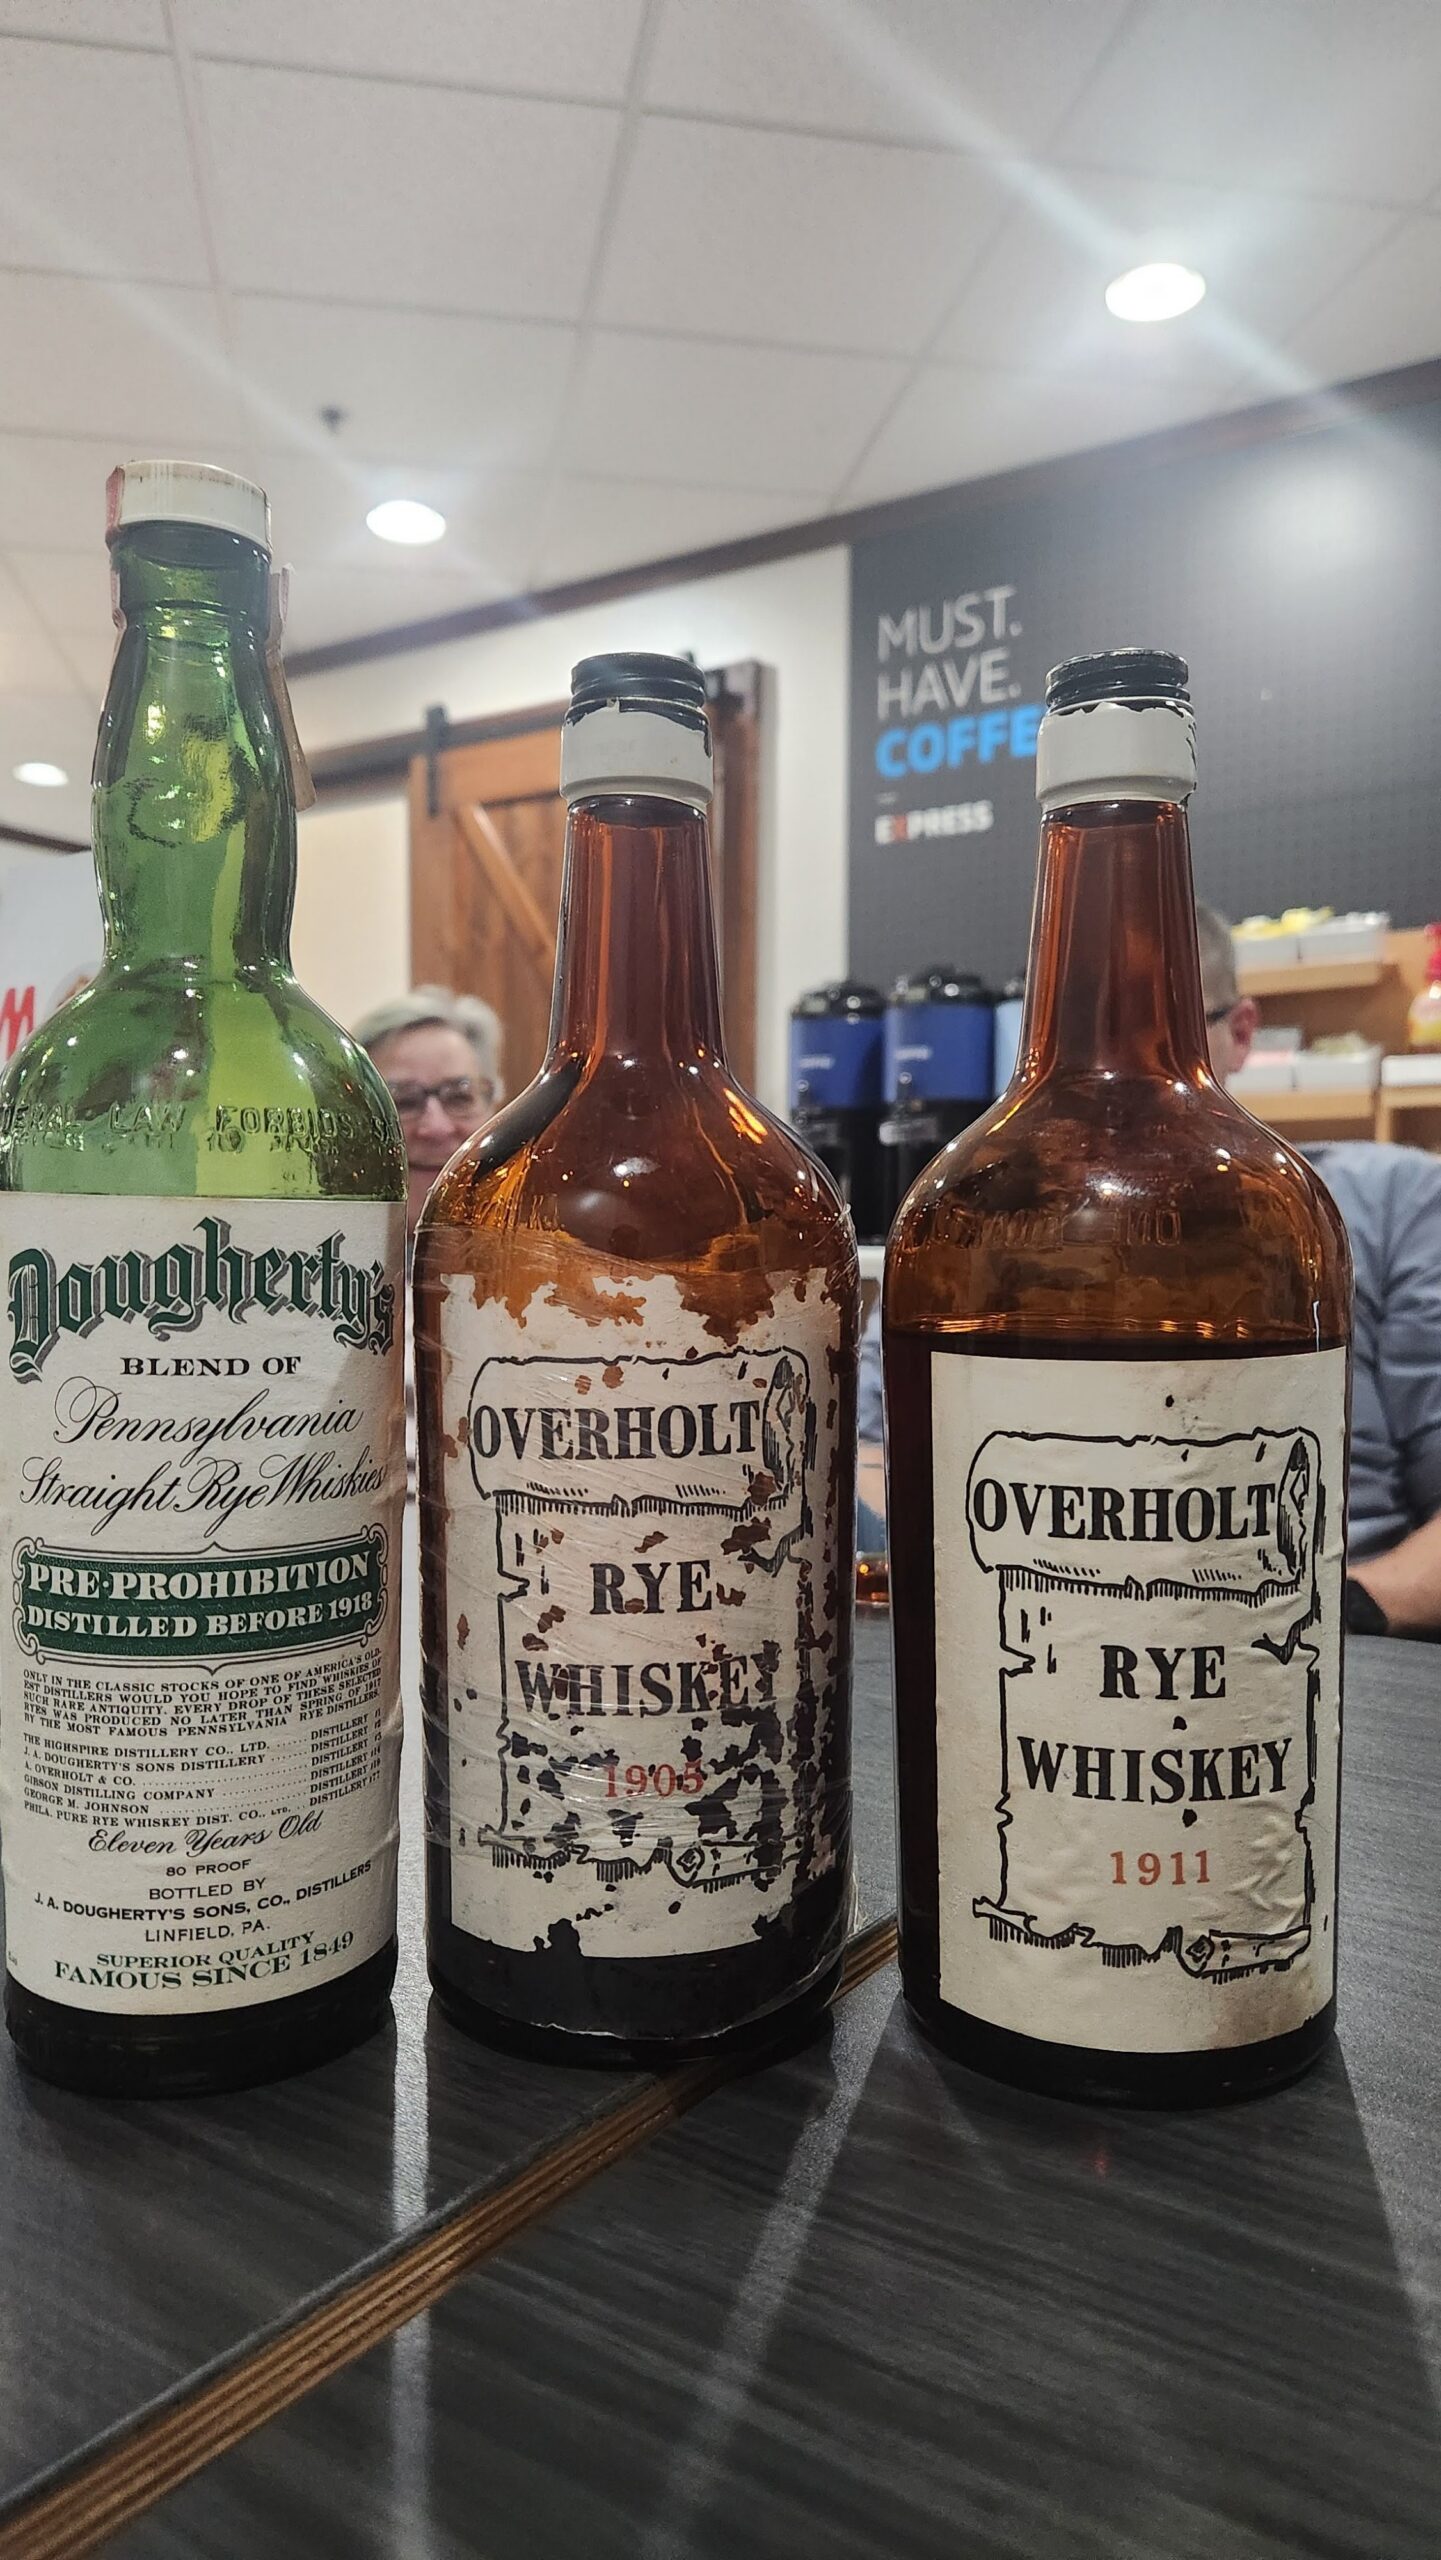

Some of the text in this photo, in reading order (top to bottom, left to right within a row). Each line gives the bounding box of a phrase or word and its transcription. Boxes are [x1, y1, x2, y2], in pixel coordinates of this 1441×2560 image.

[877, 584, 1023, 663] MUST.
[877, 646, 1022, 721] HAVE.
[874, 702, 1045, 778] COFFE
[8, 1216, 395, 1384] Dougherty's
[120, 1356, 301, 1377] BLEND OF
[53, 1376, 364, 1468] Pennsylvania
[472, 1400, 760, 1460] OVERHOLT
[20, 1445, 388, 1538] Straight Rye Whiskies
[973, 1478, 1276, 1543] OVERHOLT
[590, 1559, 712, 1615] RYE
[27, 1591, 372, 1638] DISTILLED BEFORE 1918
[23, 1669, 48, 1683] ONLY
[51, 1675, 63, 1686] IN
[67, 1678, 91, 1690] THE
[96, 1681, 155, 1692] CLASSIC
[160, 1681, 220, 1692] STOCKS
[225, 1679, 245, 1689] OF
[250, 1674, 280, 1686] ONE
[284, 1670, 302, 1682] OF
[305, 1655, 362, 1678] AMERICA'S
[24, 1680, 40, 1692] EST
[44, 1685, 112, 1703] DISTILLERS
[119, 1694, 173, 1704] WOULD
[180, 1692, 210, 1703] YOU
[218, 1688, 258, 1701] HOPE
[264, 1685, 282, 1696] TO
[288, 1679, 317, 1692] FIND
[322, 1662, 370, 1684] WHISKIES
[24, 1691, 49, 1706] SUCH
[53, 1698, 85, 1712] RARE
[174, 1703, 222, 1715] EVERY
[228, 1698, 268, 1711] DROP
[273, 1694, 292, 1705] OF
[296, 1684, 335, 1702] THESE
[339, 1667, 381, 1691] SELECTED
[514, 1654, 778, 1718] WHISKEY
[1099, 1644, 1226, 1700] RYE
[24, 1702, 47, 1716] RYES
[53, 1709, 77, 1721] WAS
[85, 1713, 161, 1726] PRODUCED
[170, 1716, 191, 1726] NO
[200, 1711, 247, 1724] LATER
[255, 1704, 293, 1718] THAN
[300, 1693, 343, 1711] SPRING
[348, 1687, 361, 1698] OF
[24, 1712, 35, 1723] BY
[39, 1717, 61, 1730] THE
[67, 1722, 101, 1735] MOST
[109, 1726, 168, 1737] FAMOUS
[178, 1716, 287, 1736] PENNSYLVANIA
[300, 1708, 323, 1722] RYE
[23, 1732, 41, 1746] THE
[44, 1739, 109, 1757] HIGHSPIRE
[114, 1747, 198, 1758] DISTILLERY
[311, 1713, 369, 1741] DISTILLERY
[24, 1746, 30, 1756] J.
[33, 1749, 42, 1760] A.
[44, 1752, 130, 1772] DOUGHERTY'S
[135, 1763, 175, 1773] SONS
[181, 1754, 266, 1772] DISTILLERY
[311, 1726, 369, 1753] DISTILLERY
[24, 1774, 59, 1792] GIBSON
[64, 1784, 136, 1800] DISTILLING
[143, 1788, 215, 1801] COMPANY
[310, 1752, 369, 1781] DISTILLERY
[34, 1764, 94, 1783] OVERHOLT
[98, 1775, 107, 1785] &
[113, 1776, 136, 1786] CO.
[311, 1739, 369, 1767] DISTILLERY
[603, 1759, 704, 1798] 1905
[1017, 1735, 1293, 1805] WHISKEY
[24, 1787, 64, 1806] GEORGE
[67, 1798, 80, 1809] M.
[84, 1801, 149, 1814] JOHNSON
[310, 1765, 369, 1794] DISTILLERY
[24, 1800, 53, 1818] PHILA.
[56, 1810, 88, 1824] PURE
[92, 1815, 119, 1827] RYE
[124, 1816, 190, 1828] WHISKEY
[196, 1814, 233, 1826] DIST.
[309, 1778, 368, 1807] DISTILLERY
[88, 1809, 324, 1858] Eleven Years Old
[34, 1892, 44, 1905] J.
[47, 1896, 59, 1910] A.
[63, 1900, 185, 1921] DOUGHERTY'S
[193, 1902, 251, 1919] SONS,
[296, 1859, 372, 1901] DISTILLERS
[149, 1877, 267, 1900] BOTTLED BY
[166, 1858, 252, 1877] 80 PROOF
[1110, 1849, 1211, 1886] 1911
[96, 1930, 315, 1969] SUPERIOR QUALITY
[242, 1919, 271, 1935] PA.
[54, 1930, 354, 1990] FAMOUS SINCE 1849
